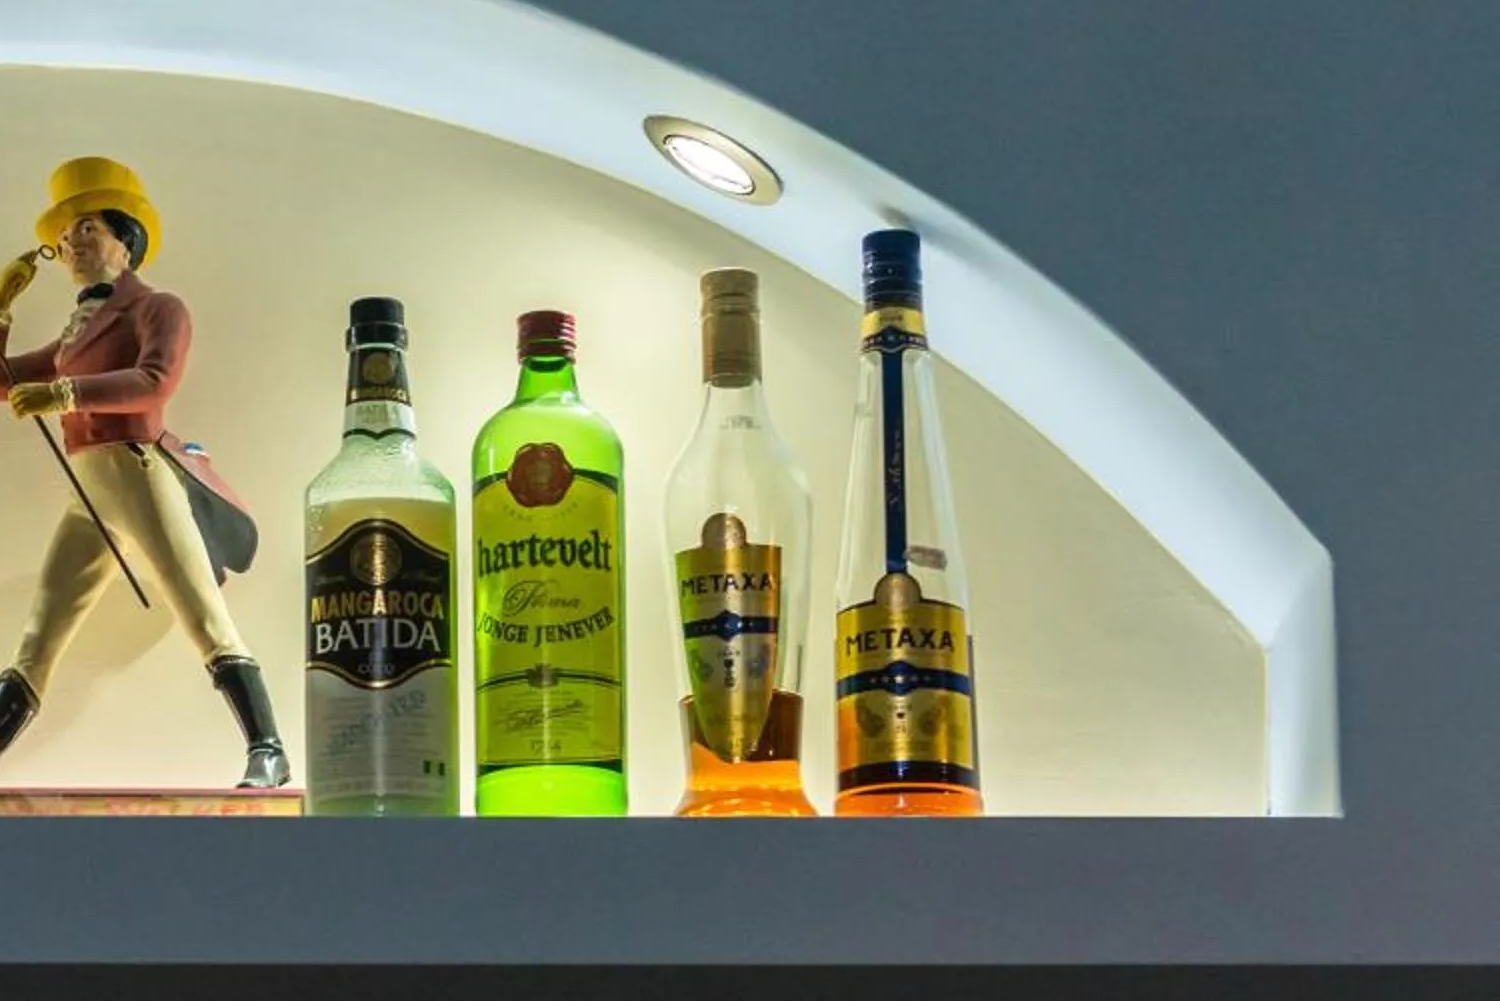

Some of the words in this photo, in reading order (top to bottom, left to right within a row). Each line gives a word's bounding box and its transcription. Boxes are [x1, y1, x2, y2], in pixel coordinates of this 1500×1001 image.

[477, 528, 613, 578] hartevelt
[681, 572, 773, 597] METAXA
[311, 587, 445, 624] MANGAROCA
[315, 617, 441, 655] BATIDA
[534, 605, 616, 648] JENEVER
[845, 626, 955, 657] METAXA
